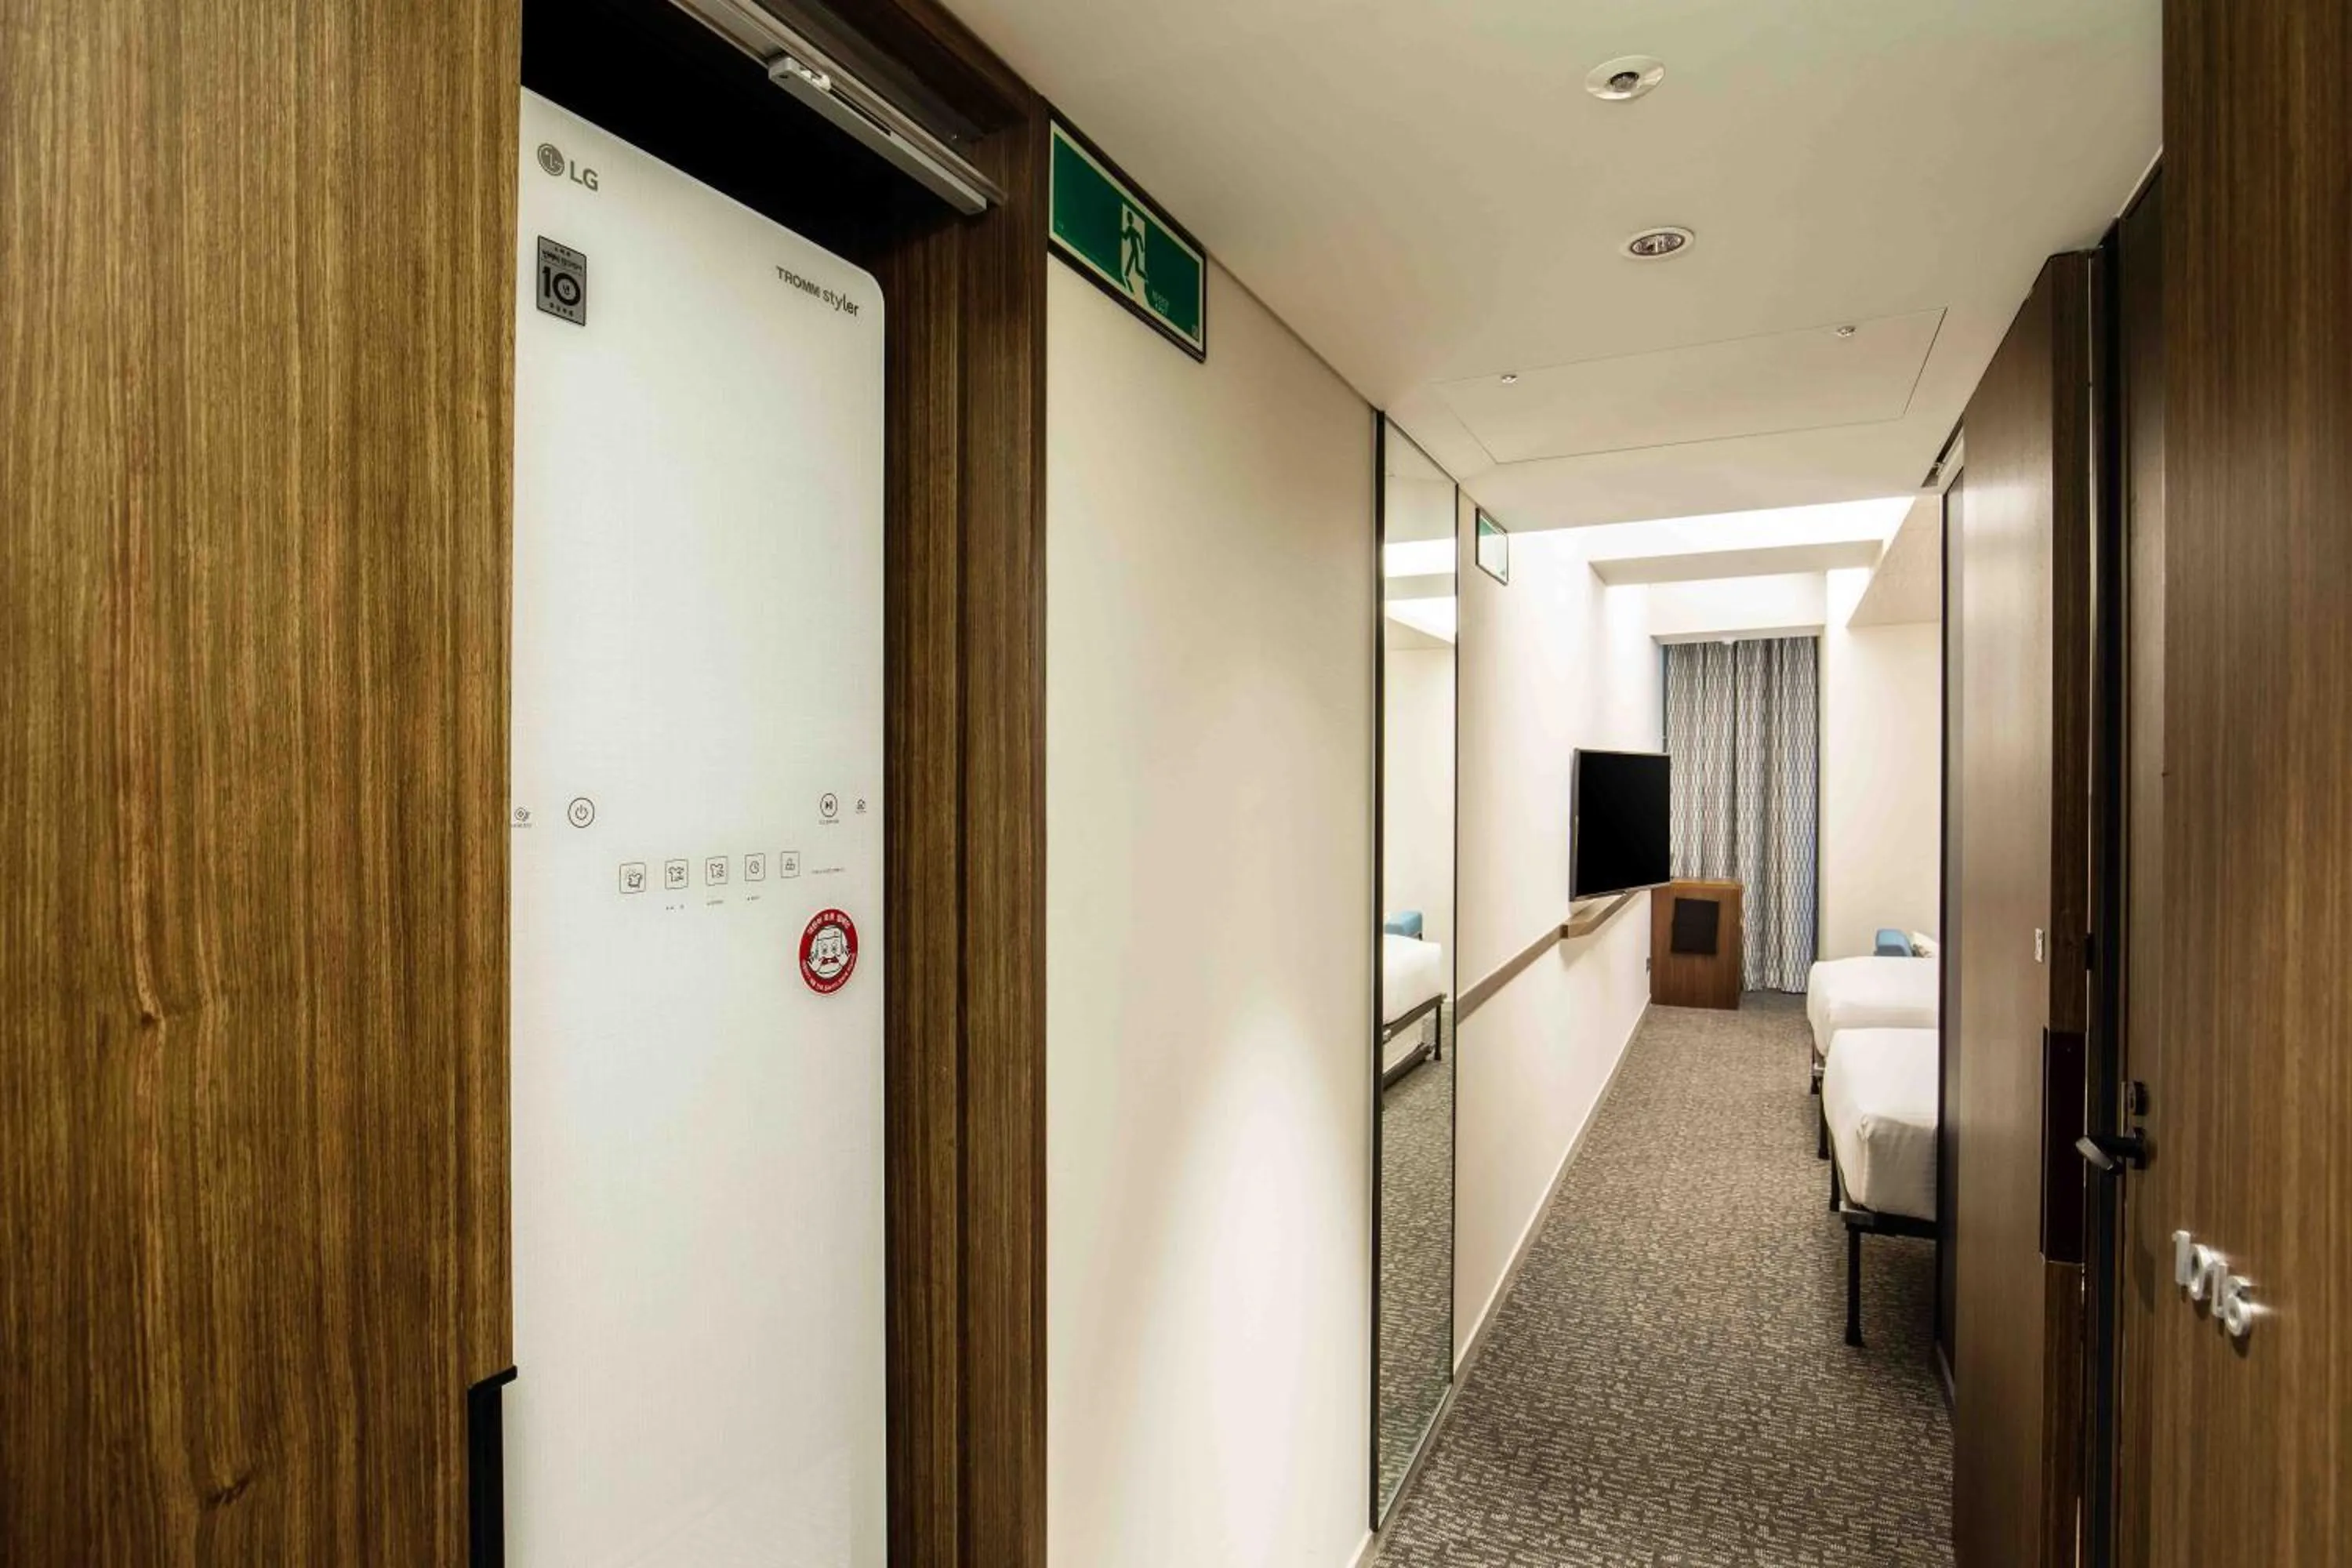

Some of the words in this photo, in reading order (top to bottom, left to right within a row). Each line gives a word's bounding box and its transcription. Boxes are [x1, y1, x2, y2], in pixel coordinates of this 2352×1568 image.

[570, 161, 598, 191] LG
[776, 266, 821, 298] TROMM
[823, 289, 859, 317] styler
[2172, 1230, 2252, 1337] 1016
